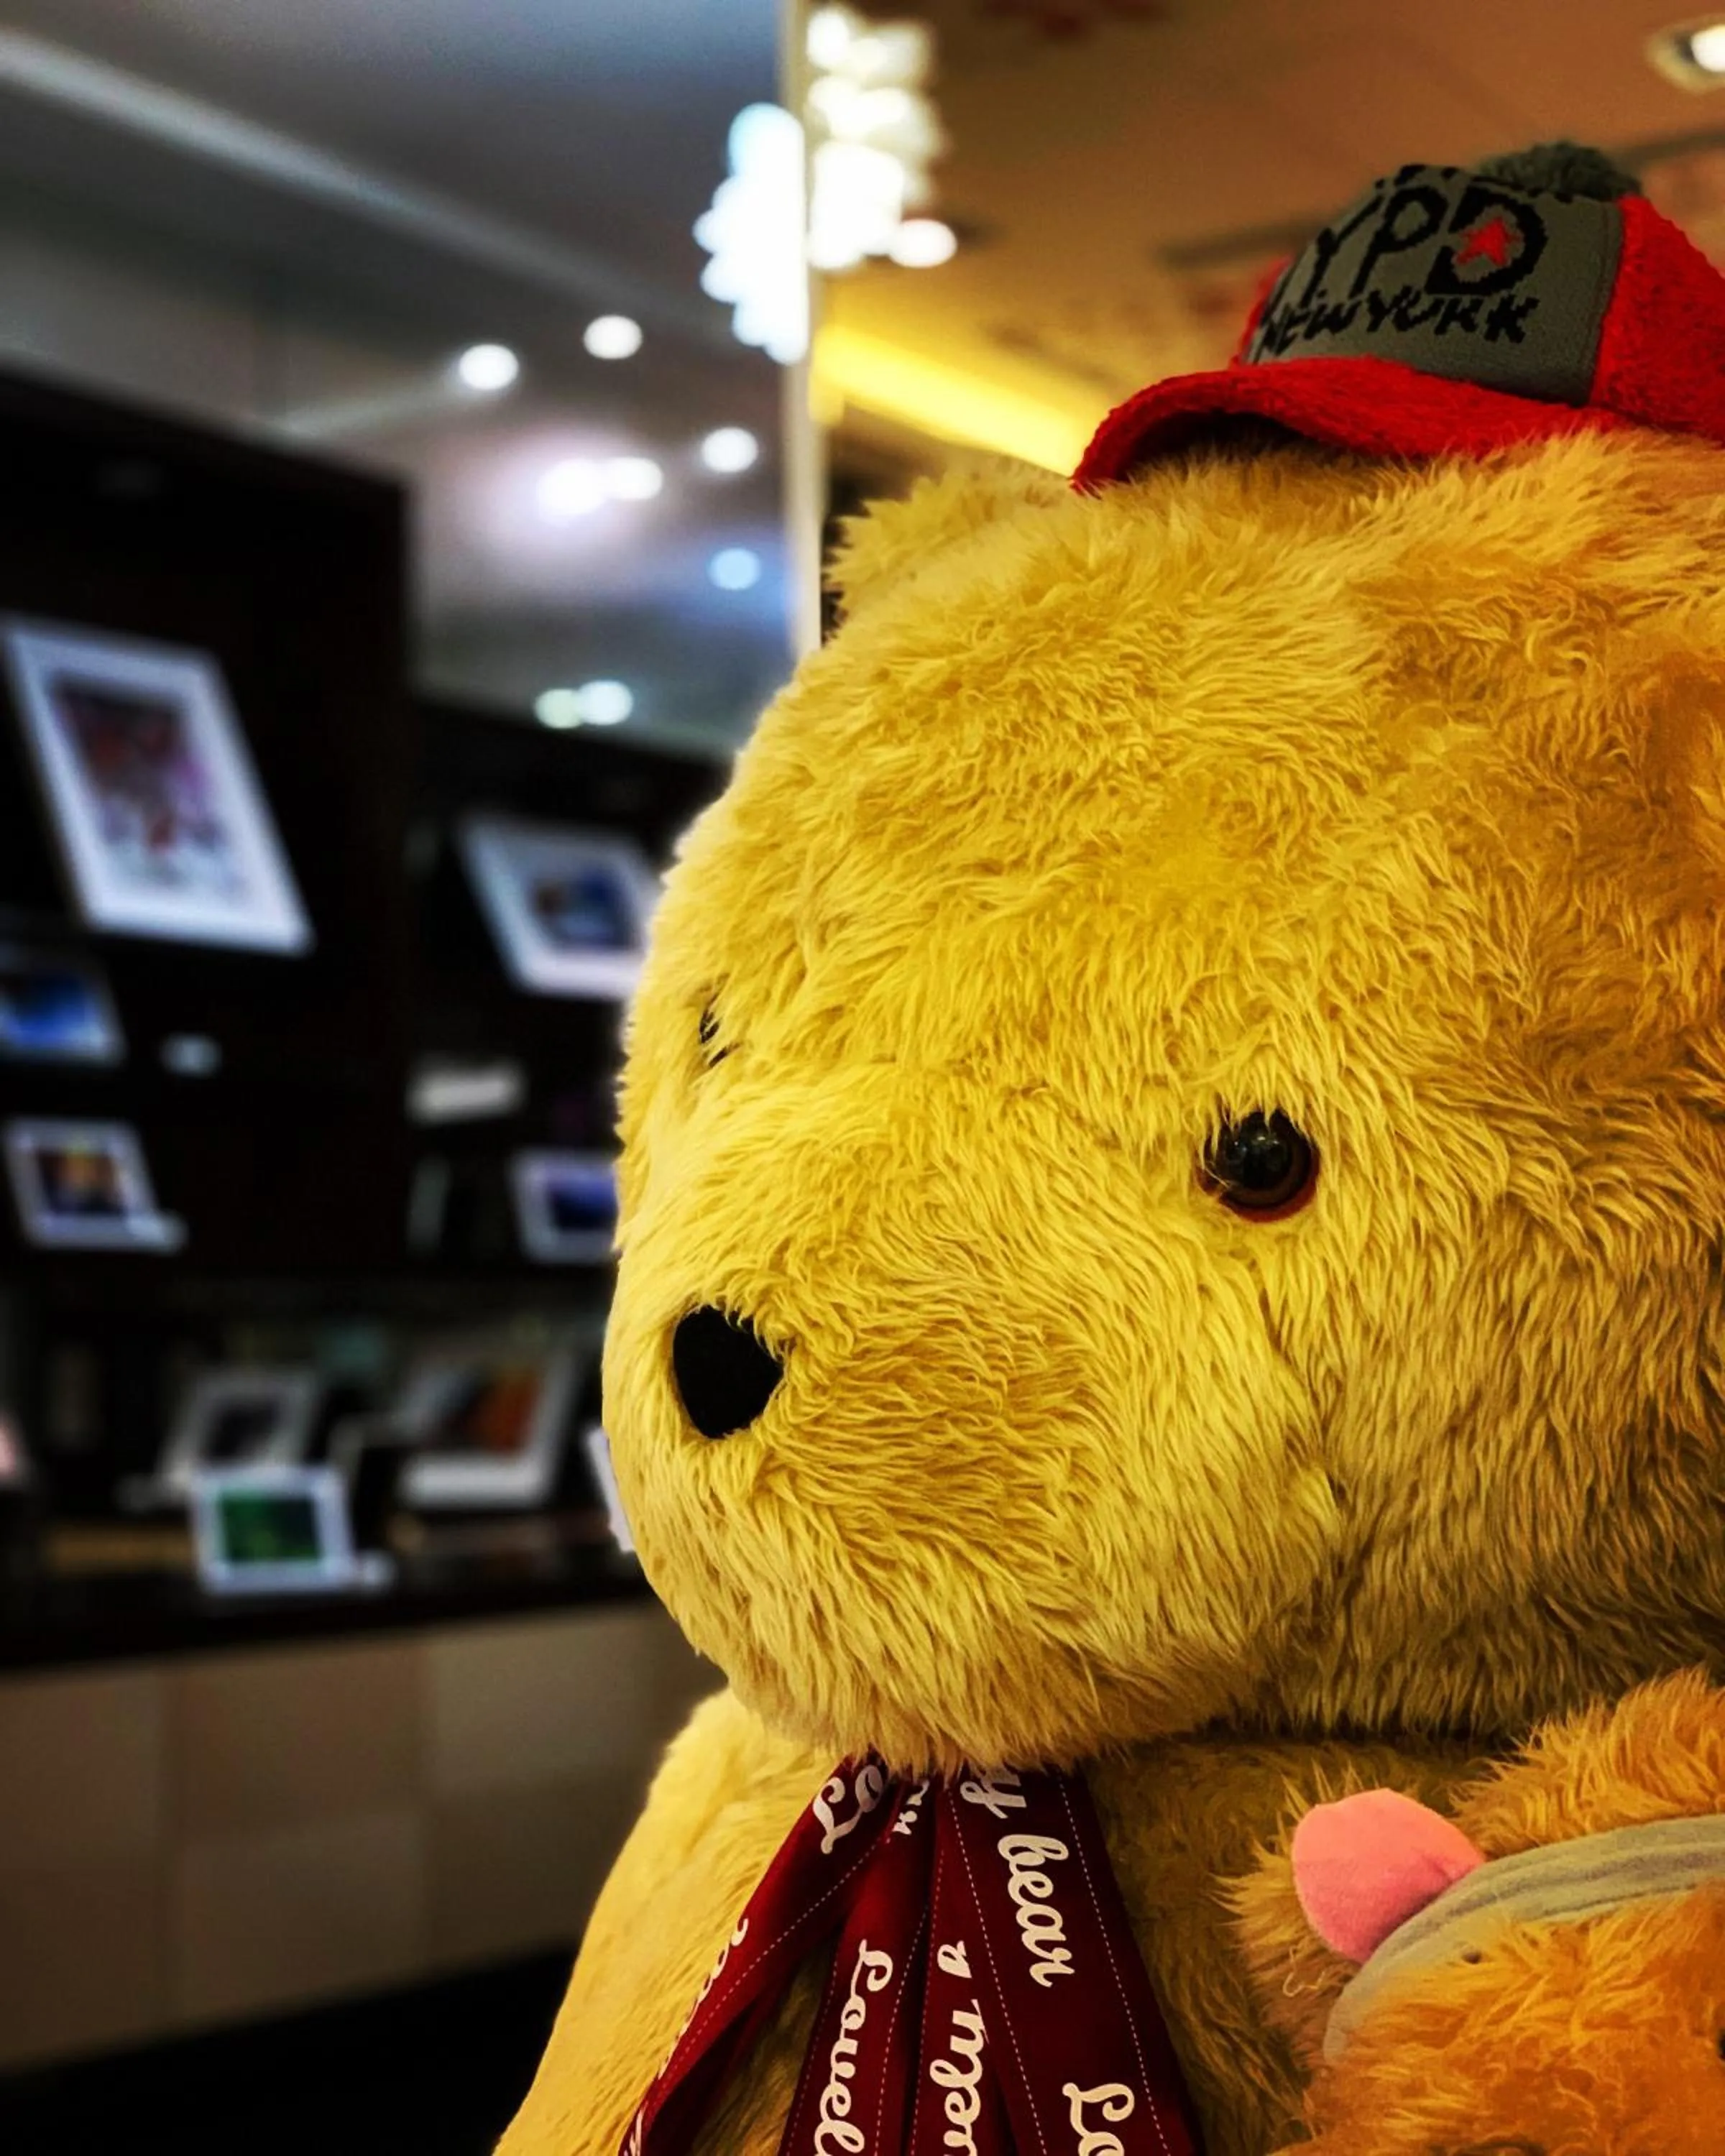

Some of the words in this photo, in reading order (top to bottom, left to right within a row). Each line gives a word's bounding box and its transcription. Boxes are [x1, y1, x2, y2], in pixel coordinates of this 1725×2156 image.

[1262, 181, 1548, 321] YPD
[997, 1834, 1076, 1989] bear
[814, 1939, 893, 2156] Lovel
